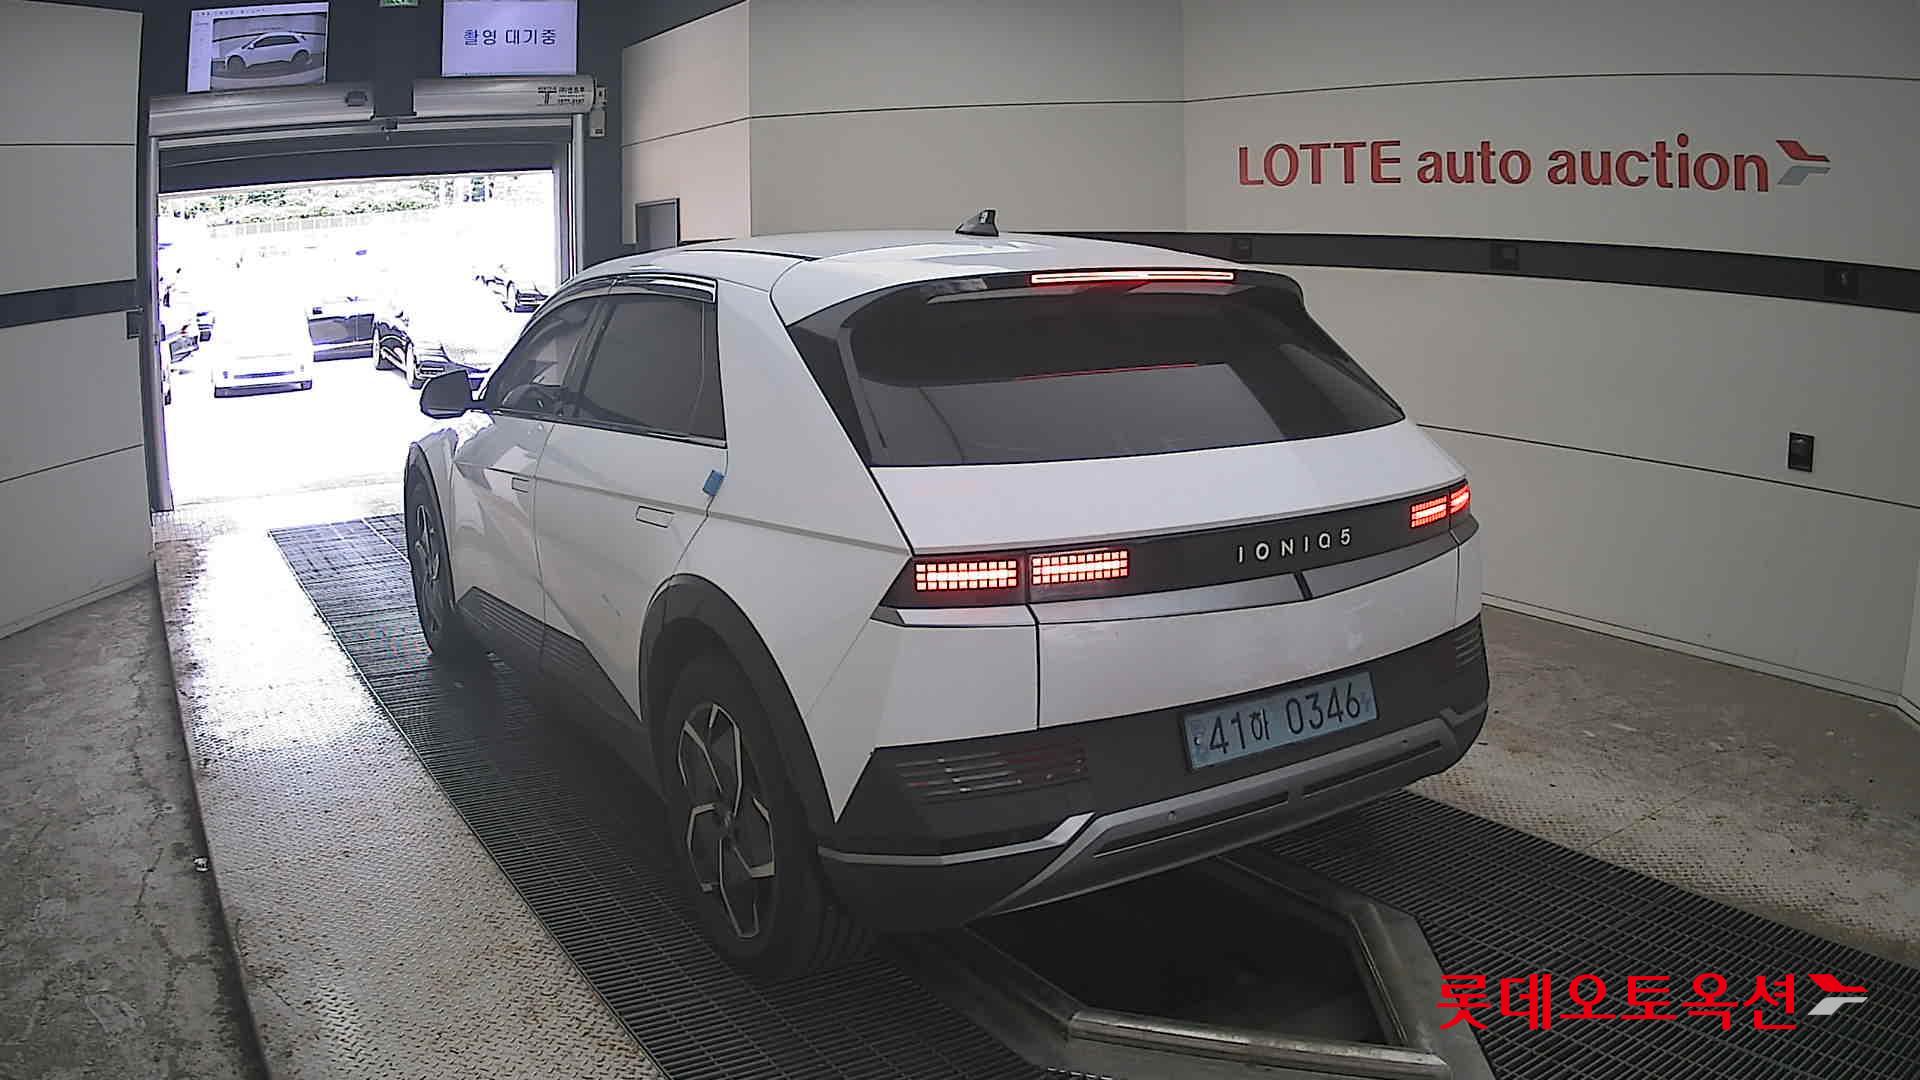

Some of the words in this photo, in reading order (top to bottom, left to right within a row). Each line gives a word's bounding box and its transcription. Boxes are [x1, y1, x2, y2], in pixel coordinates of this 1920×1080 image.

[464, 29, 497, 46] 촬영
[505, 29, 557, 46] 대기중
[1238, 140, 1402, 187] LOTTE
[1416, 140, 1532, 185] auto
[1546, 133, 1769, 192] auction
[1208, 709, 1270, 755] 41하
[1285, 682, 1361, 735] 0346
